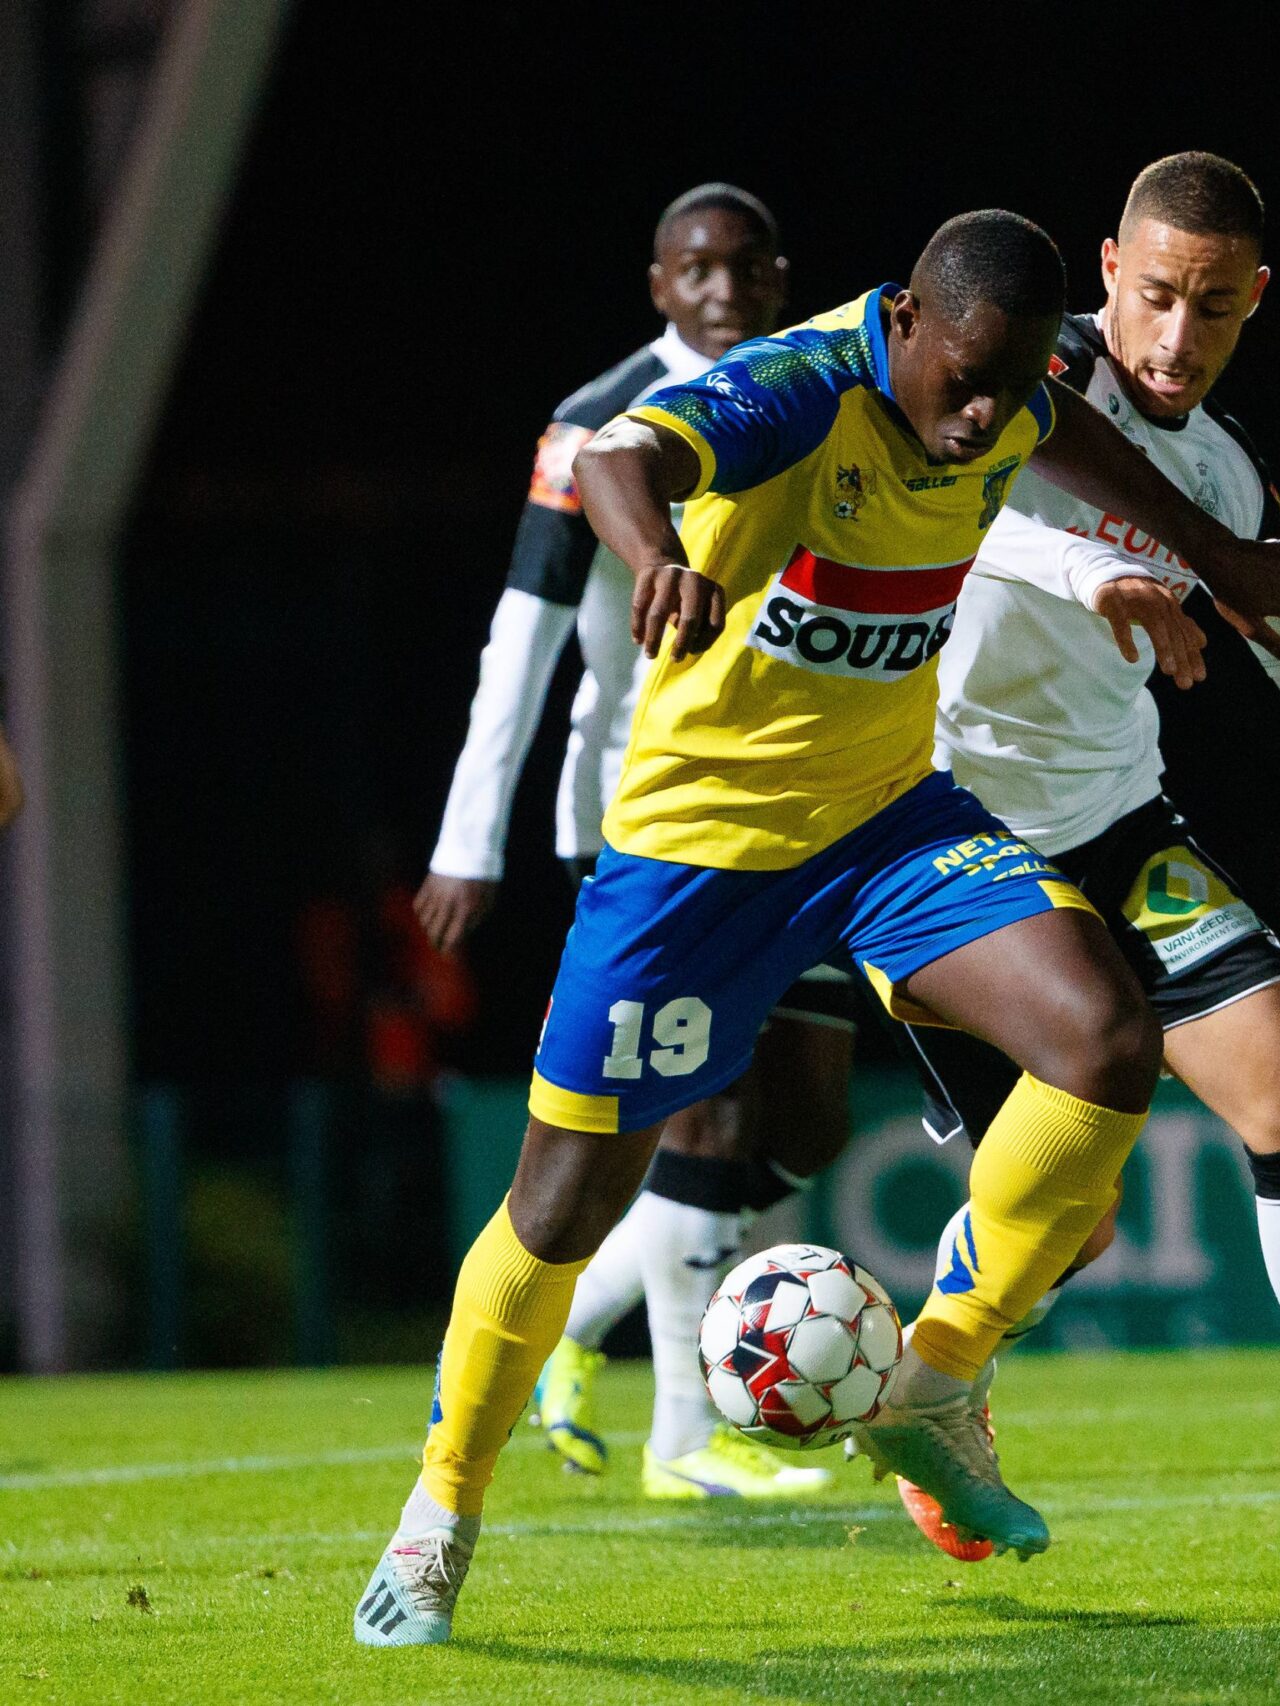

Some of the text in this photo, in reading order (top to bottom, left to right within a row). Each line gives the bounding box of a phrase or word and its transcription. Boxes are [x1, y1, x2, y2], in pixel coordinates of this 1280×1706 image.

[1163, 910, 1234, 953] VANHEEDE
[1169, 925, 1231, 964] ENVIRONMENT
[602, 997, 712, 1079] 19
